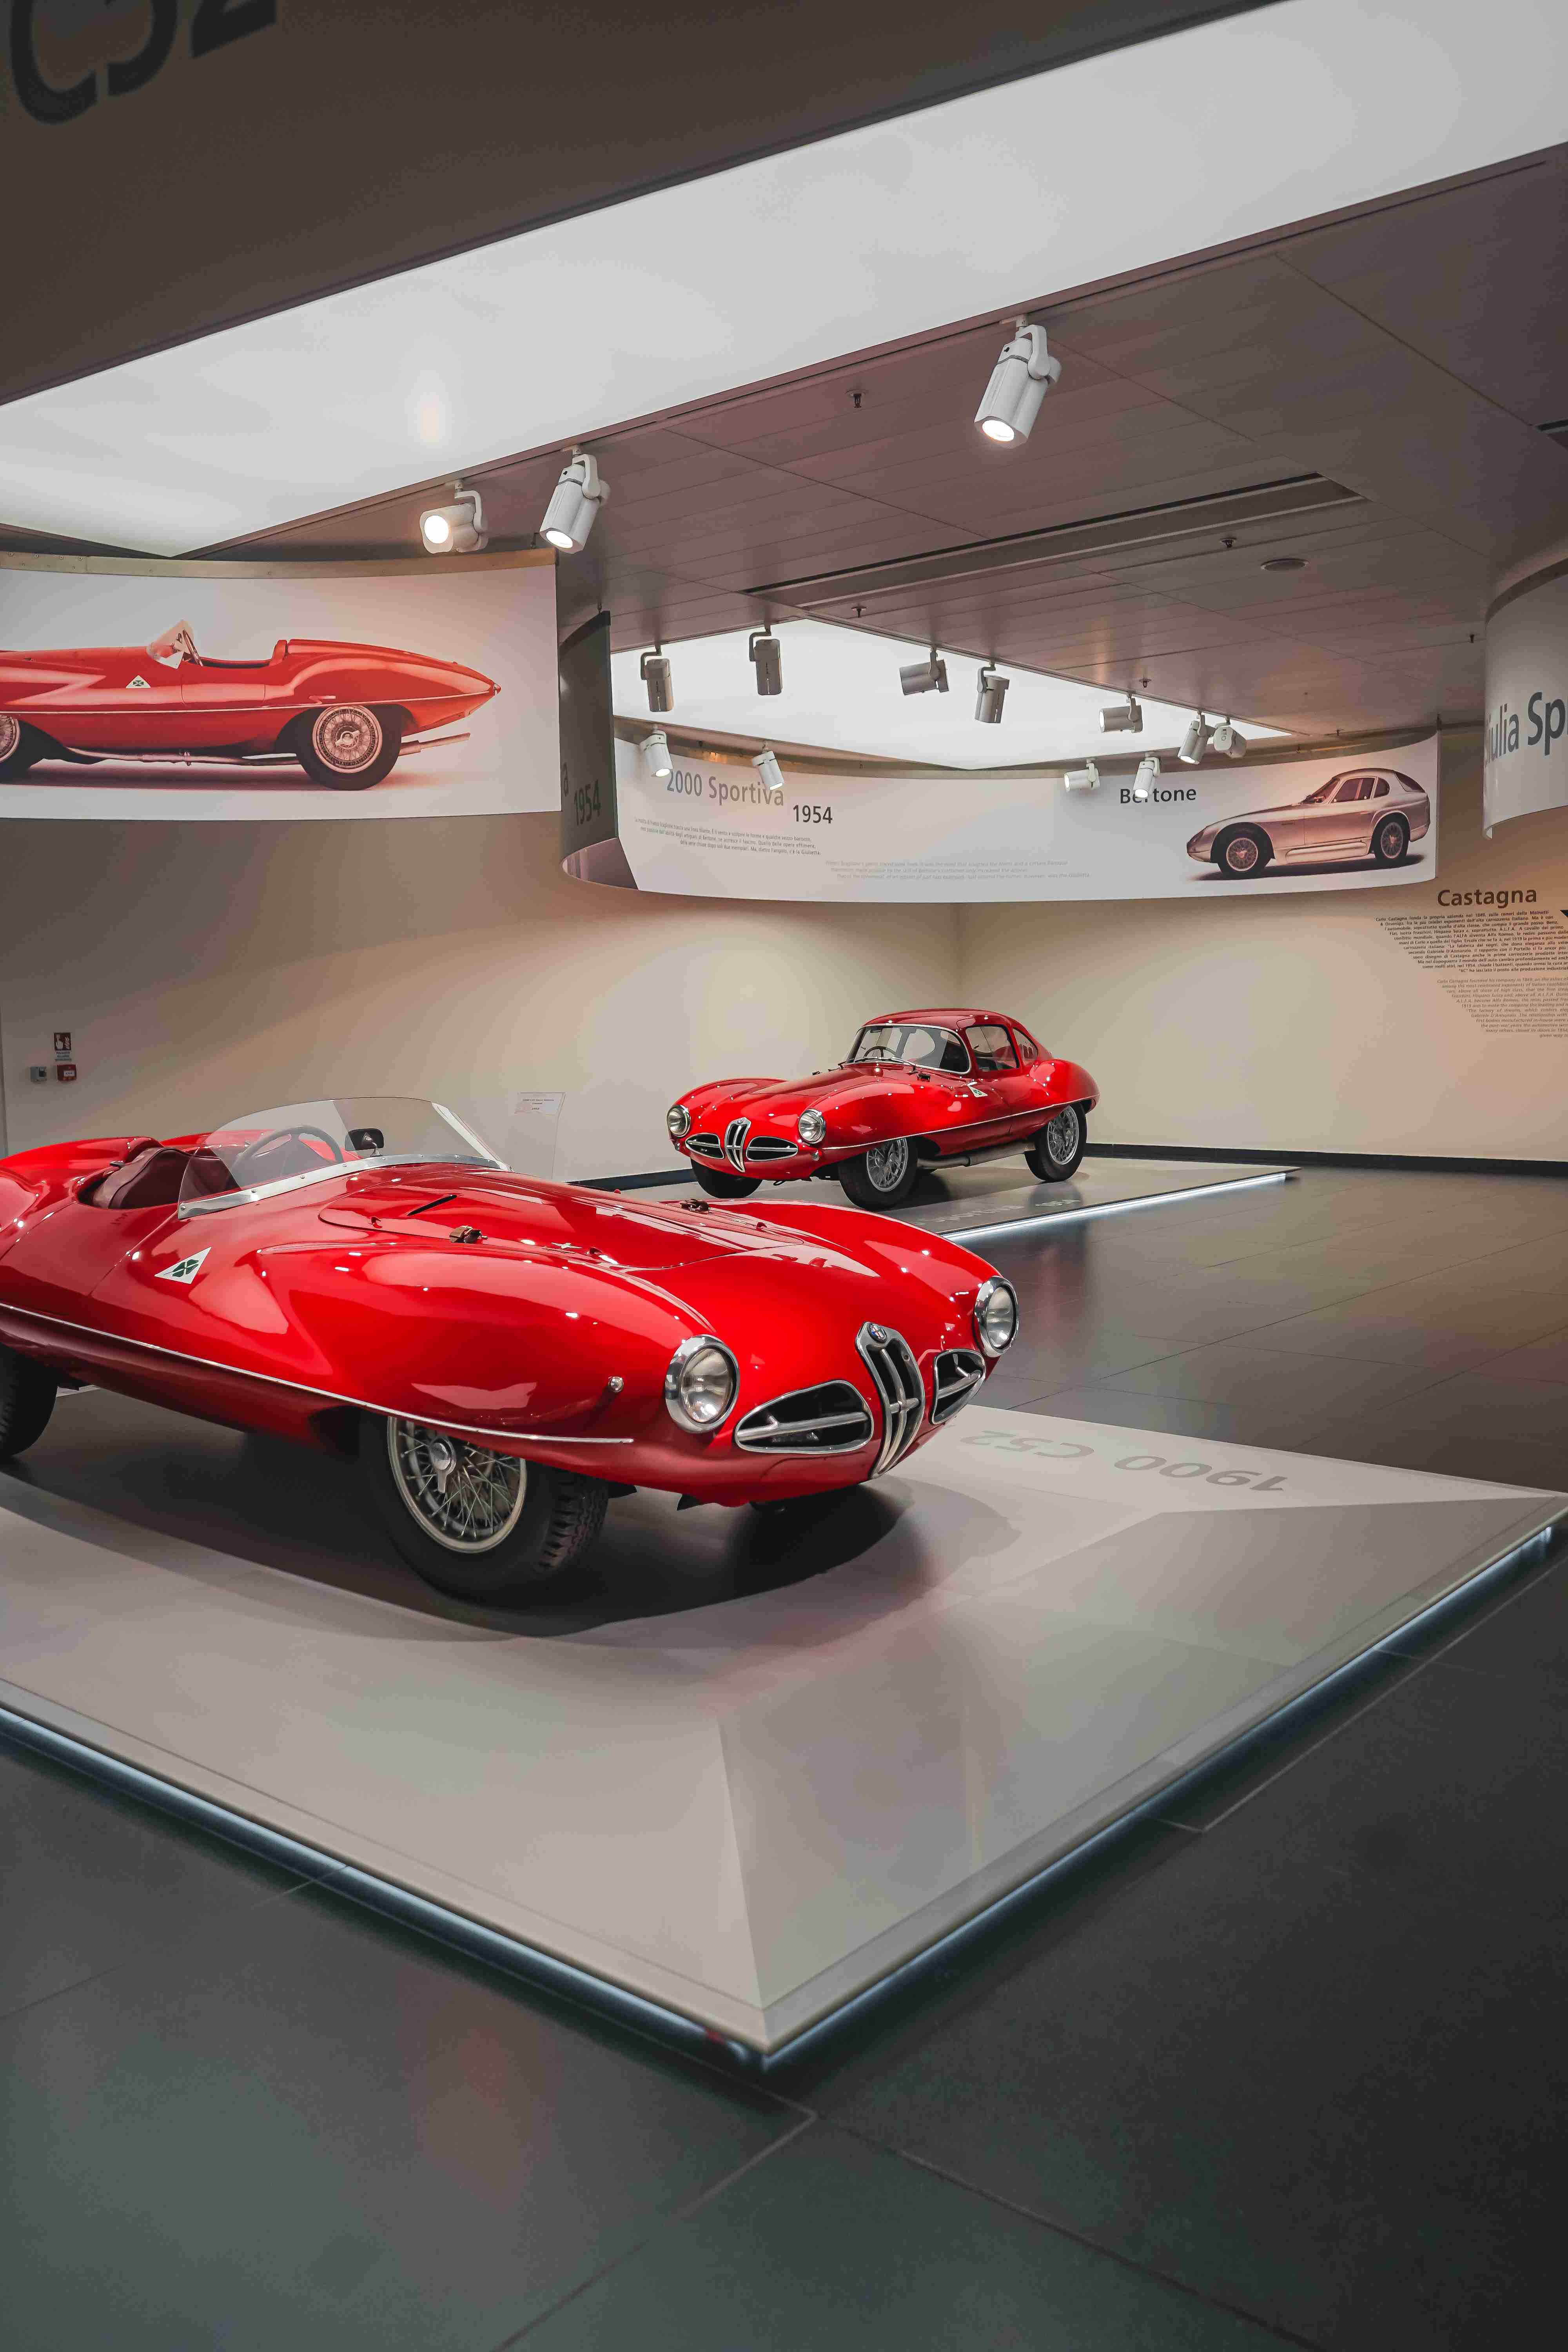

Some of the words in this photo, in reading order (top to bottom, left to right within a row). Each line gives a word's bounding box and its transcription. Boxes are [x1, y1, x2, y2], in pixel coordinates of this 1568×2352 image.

[1528, 692, 1568, 756] Sp
[667, 770, 702, 796] 2000
[574, 779, 602, 826] 1954
[793, 805, 833, 824] 1954
[1437, 889, 1537, 909] Castagna
[959, 1430, 1095, 1459] C52
[1114, 1455, 1289, 1491] 1900
